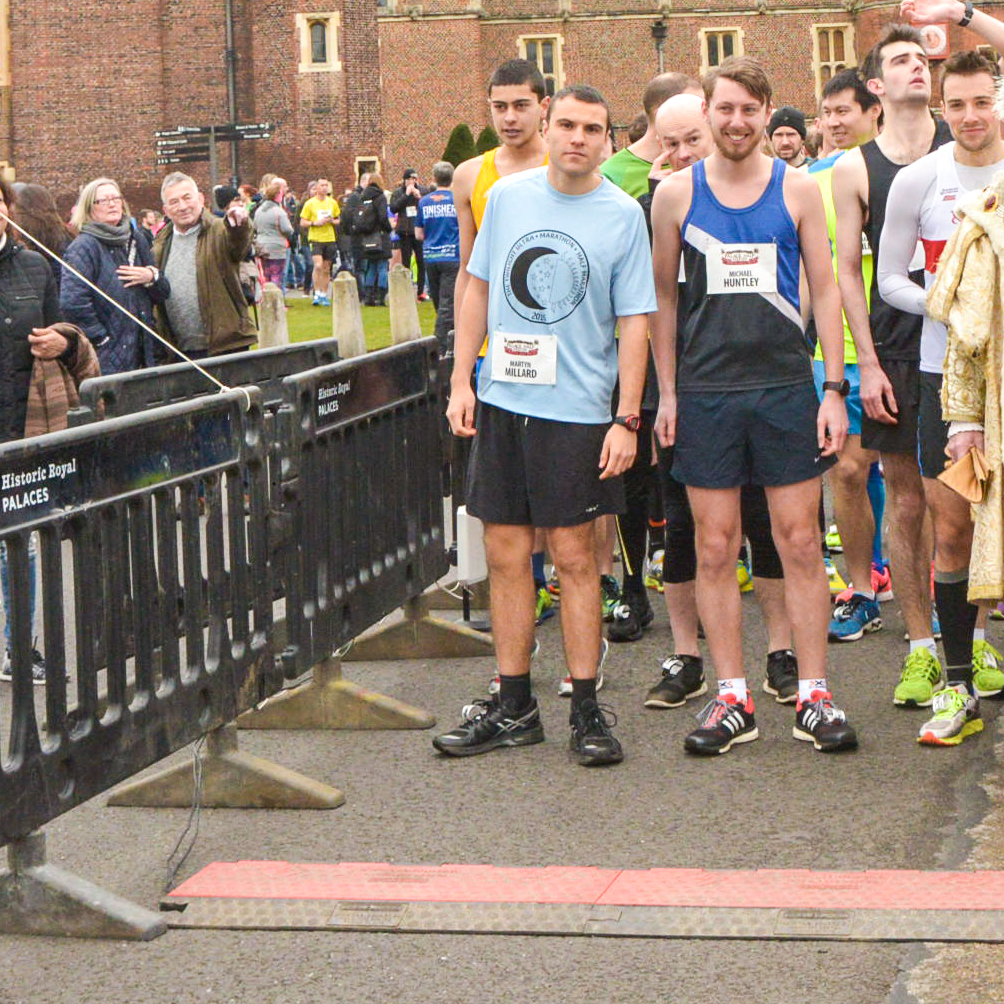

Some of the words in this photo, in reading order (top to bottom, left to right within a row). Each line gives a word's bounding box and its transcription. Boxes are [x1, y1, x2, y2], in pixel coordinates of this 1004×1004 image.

[539, 232, 576, 249] MARATHON
[723, 277, 759, 288] HUNTLEY
[509, 360, 532, 368] MARTYN
[505, 367, 537, 379] MILLARD
[318, 400, 339, 416] PALACES
[1, 466, 47, 490] Historic
[48, 458, 77, 479] Royal
[2, 487, 50, 513] PALACES
